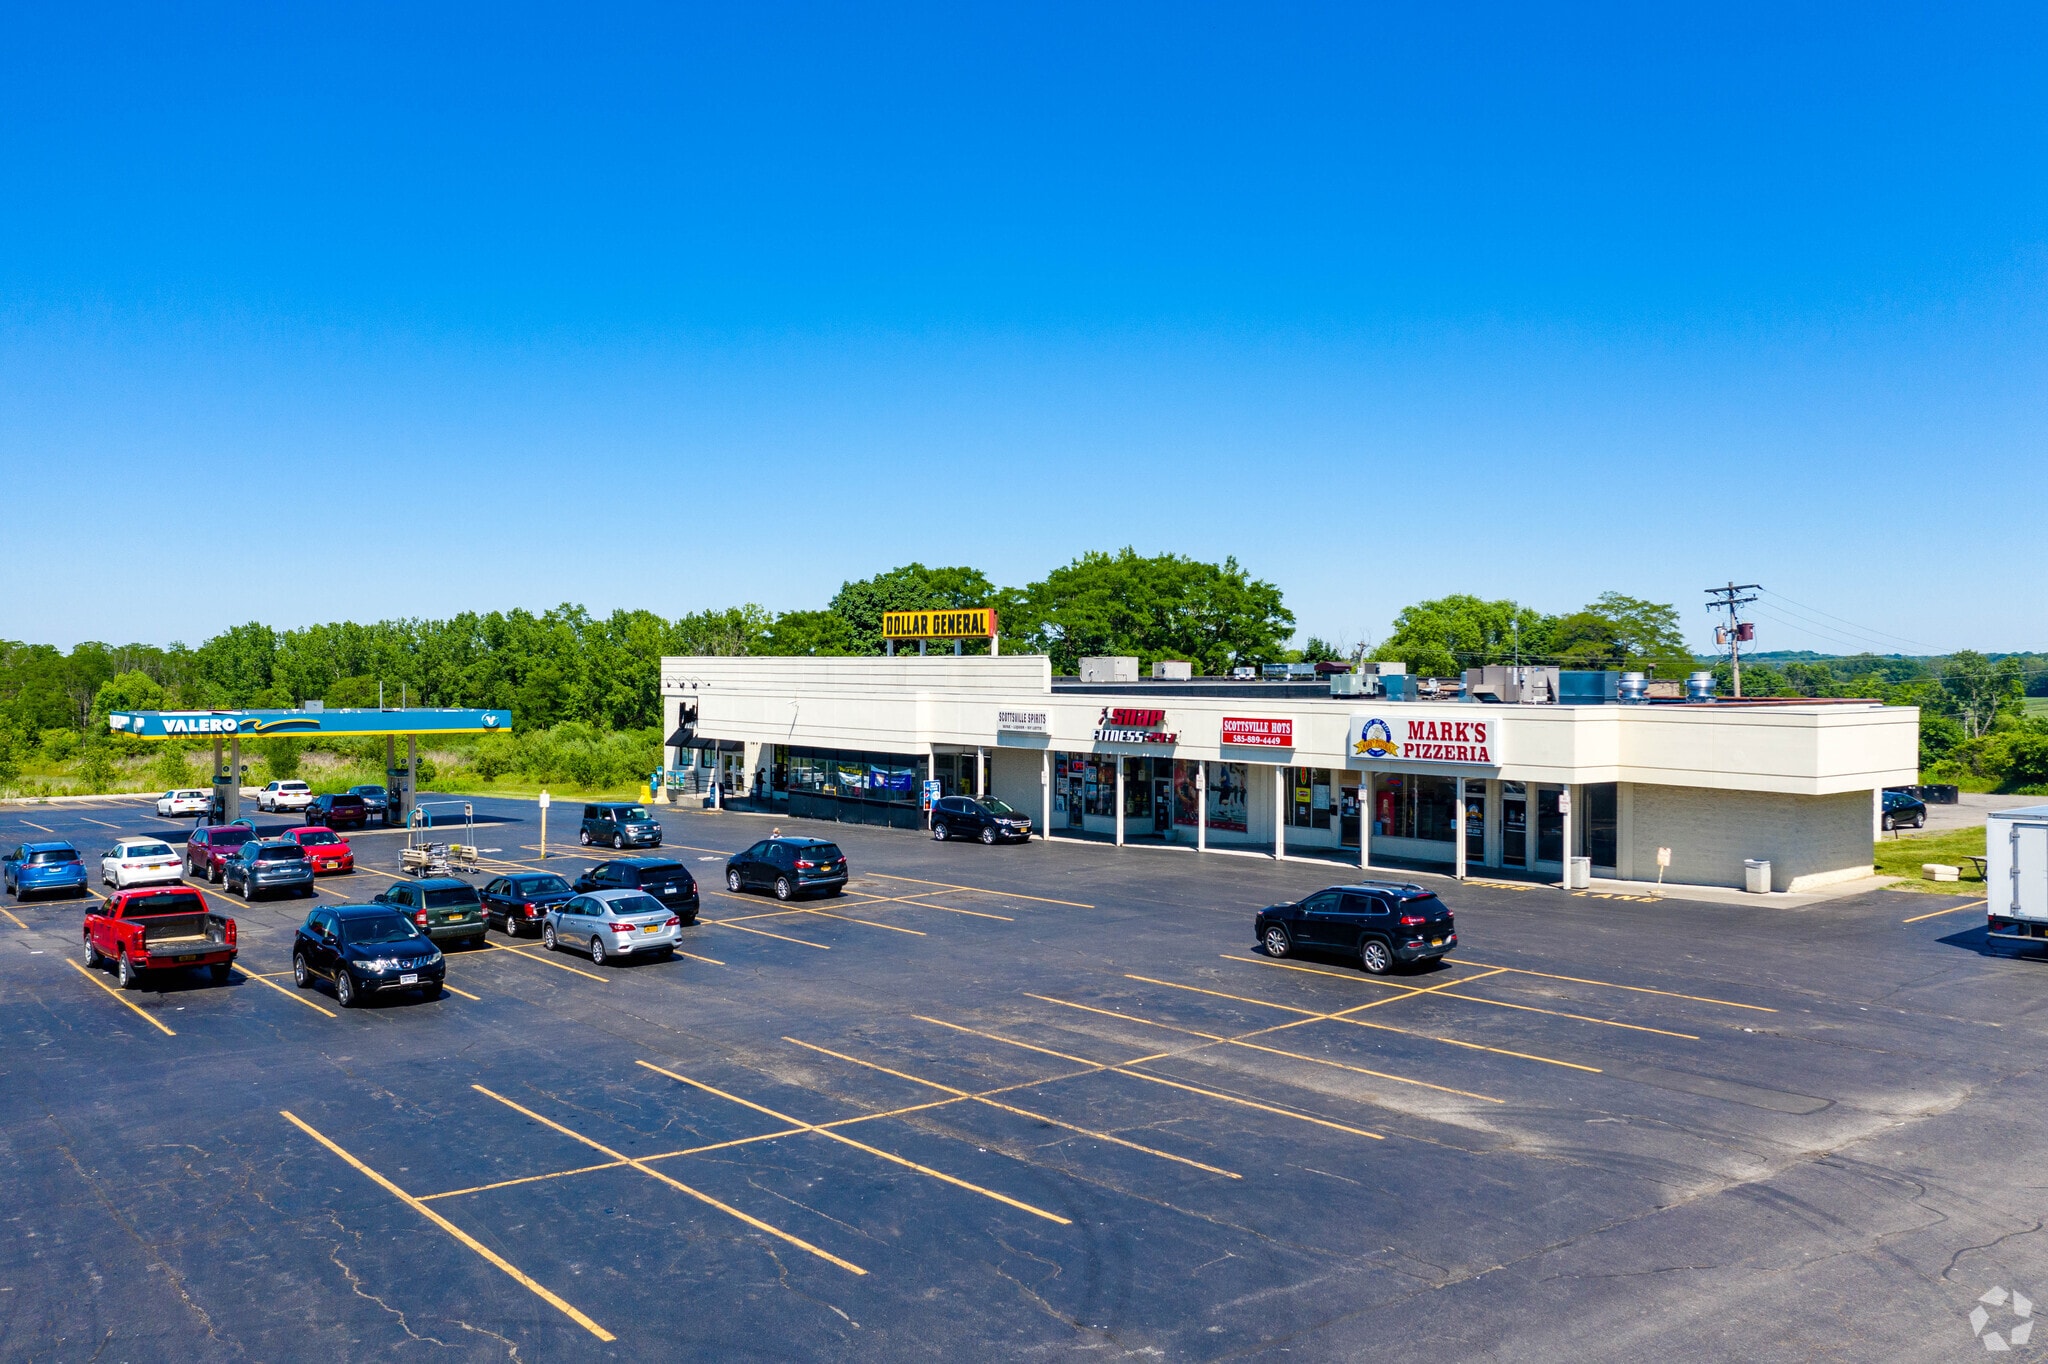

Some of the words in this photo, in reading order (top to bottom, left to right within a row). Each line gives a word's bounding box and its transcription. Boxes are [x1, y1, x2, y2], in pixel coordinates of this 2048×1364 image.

[886, 615, 928, 635] DOLLAR
[933, 613, 986, 634] GENERAL
[999, 712, 1027, 723] SCOTTSVILLE
[1028, 713, 1046, 724] SPIRITS
[162, 718, 237, 733] VALERO
[1224, 720, 1269, 733] SCOTTSVILLE
[1271, 722, 1291, 734] HOTS
[1408, 720, 1487, 743] MARK'S
[1093, 729, 1144, 743] FITNESS
[1232, 735, 1281, 745] 585-889-4449
[1403, 743, 1490, 762] PIZZERIA
[1571, 891, 1664, 903] LANE
